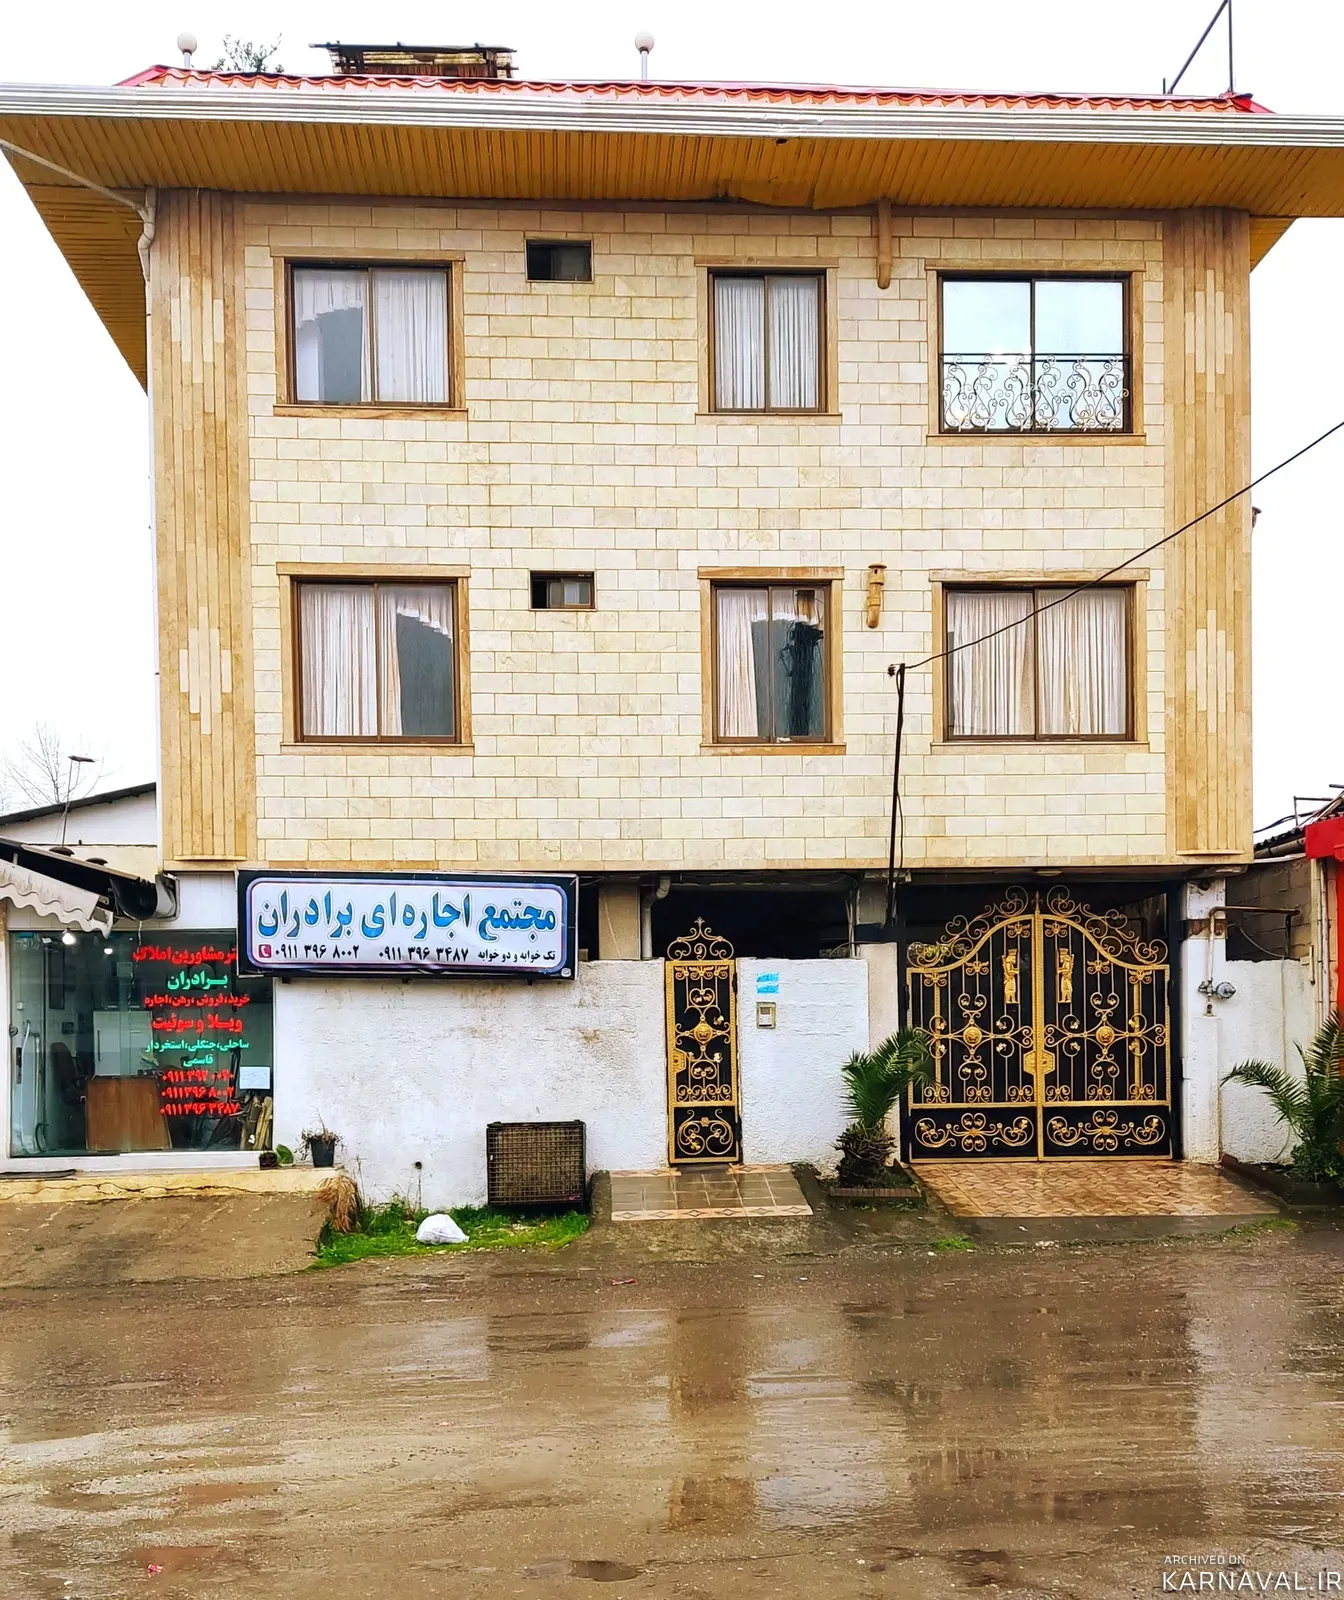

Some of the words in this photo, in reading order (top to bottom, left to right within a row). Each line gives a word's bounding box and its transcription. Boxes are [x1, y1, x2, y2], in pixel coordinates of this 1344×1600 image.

[258, 889, 353, 937] برادران
[478, 900, 556, 941] مجتمع
[132, 945, 172, 961] املاک
[171, 945, 224, 965] مشاورین
[478, 949, 499, 963] خوابه
[501, 951, 511, 963] دو
[520, 949, 541, 963] خوابه
[543, 949, 556, 961] تک
[167, 970, 228, 990] برادران
[195, 1019, 204, 1033] و
[183, 1053, 214, 1067] قاسمی
